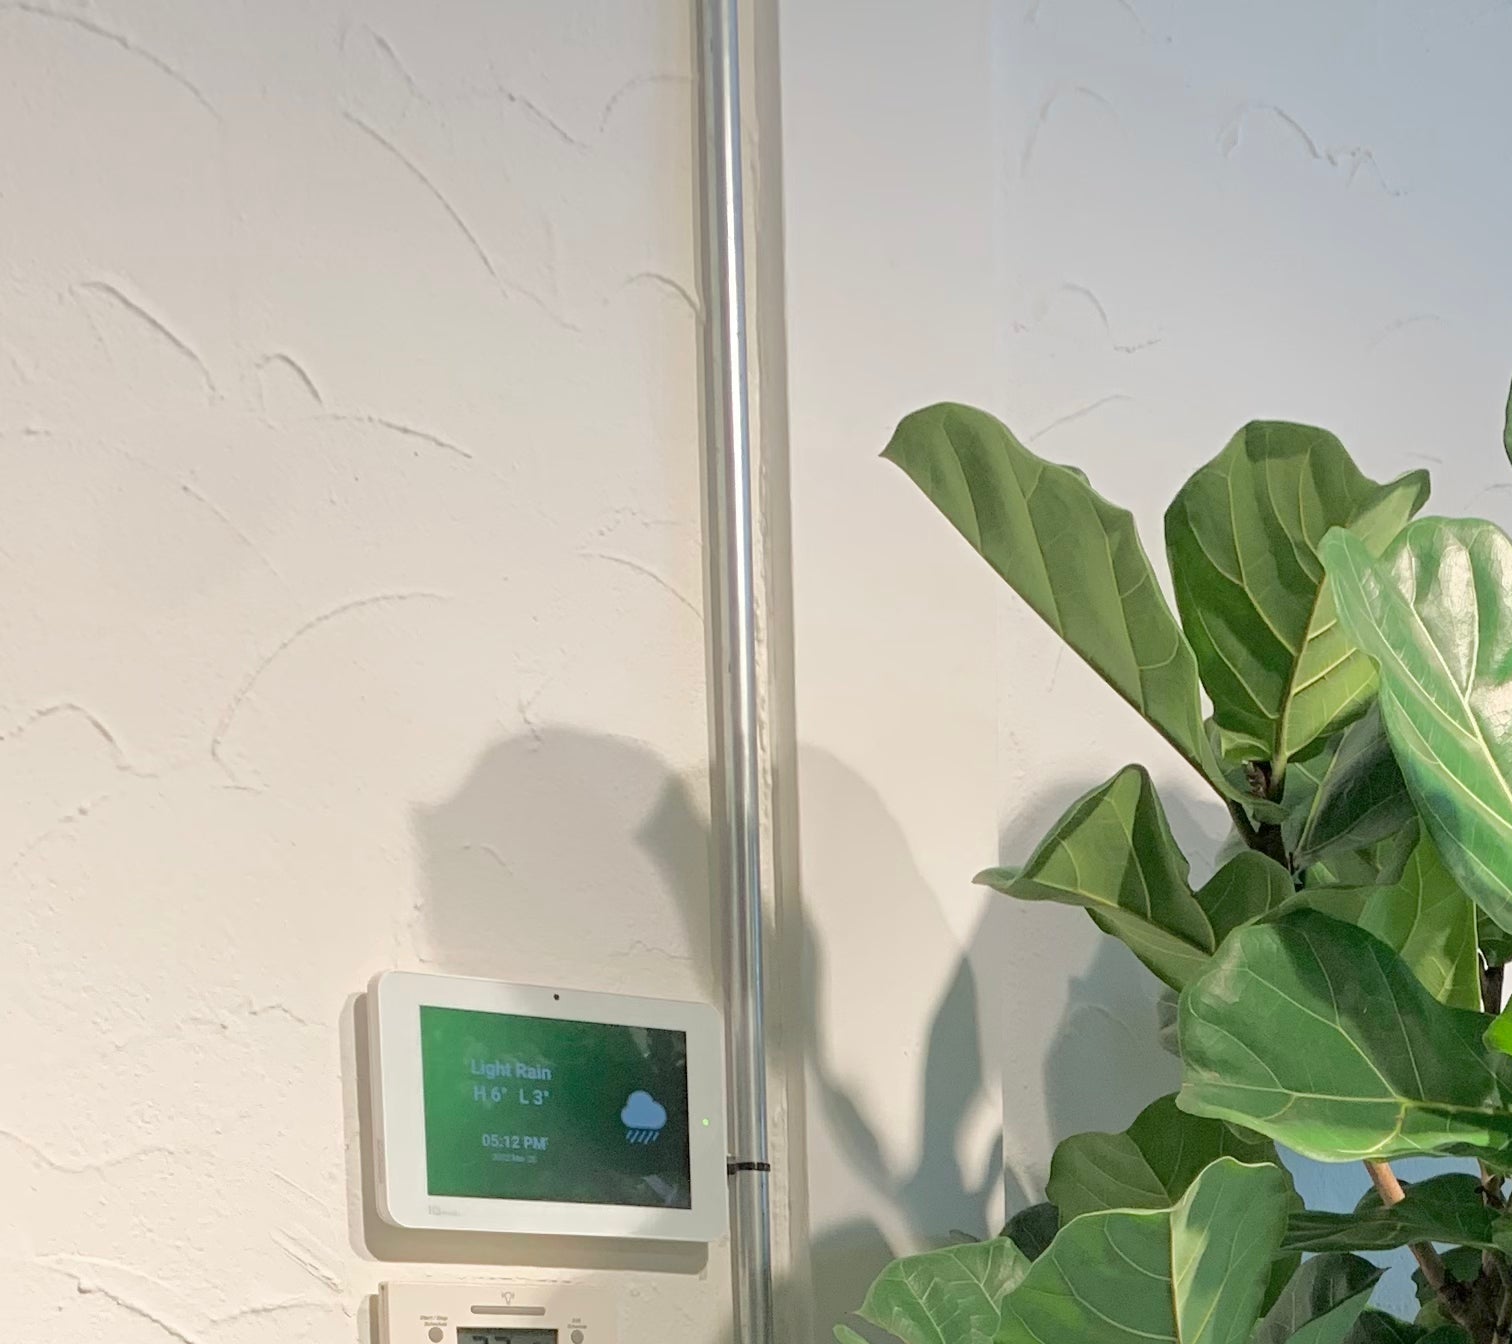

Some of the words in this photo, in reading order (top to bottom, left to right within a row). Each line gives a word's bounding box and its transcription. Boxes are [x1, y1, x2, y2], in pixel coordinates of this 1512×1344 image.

[471, 1059, 512, 1080] Light
[516, 1062, 552, 1080] Rain
[482, 1133, 521, 1149] 05:12
[524, 1135, 549, 1151] PM
